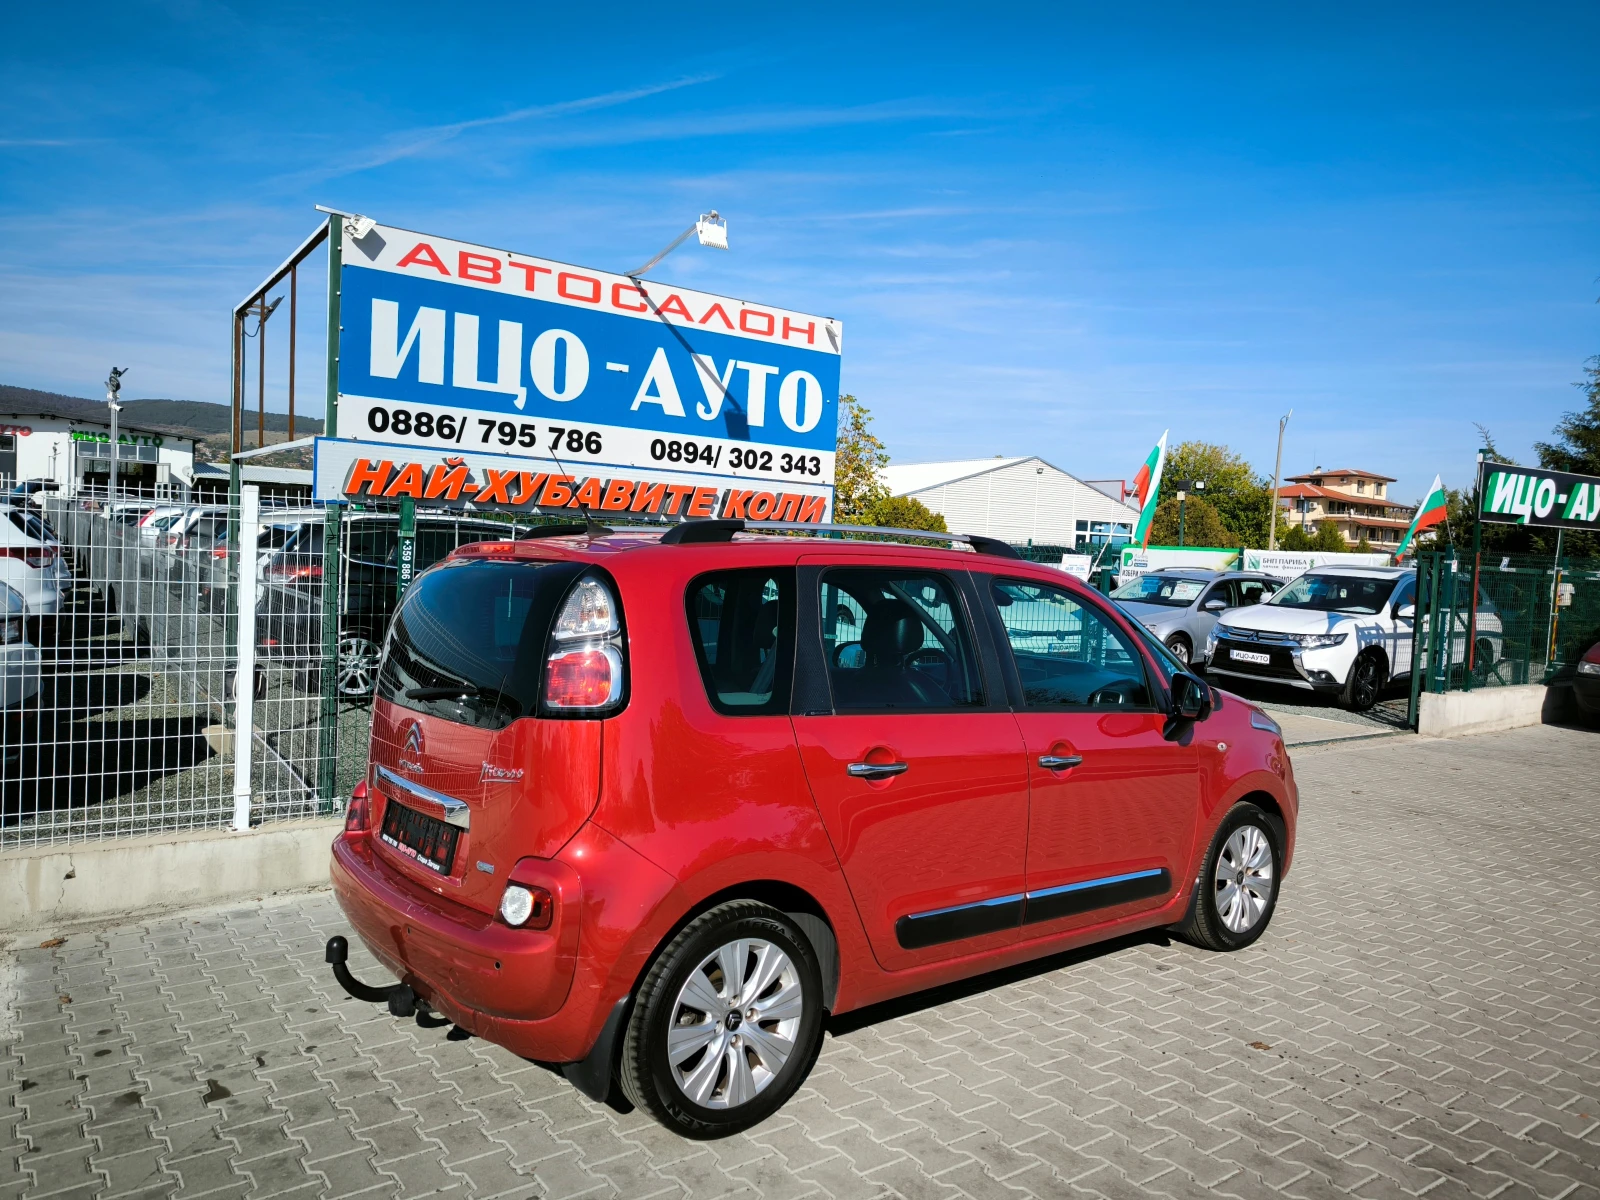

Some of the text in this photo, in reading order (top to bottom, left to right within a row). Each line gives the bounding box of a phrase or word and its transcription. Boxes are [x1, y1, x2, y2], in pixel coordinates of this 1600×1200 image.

[396, 242, 815, 344] АВТОСАЛОН
[367, 406, 602, 454] 0886/ 795 786
[650, 439, 821, 476] 0894/ 302 343
[345, 456, 826, 523] НАЙ-ХУБАВИТЕ КОЛИ
[402, 540, 412, 561] +359
[401, 564, 411, 580] 886
[1235, 652, 1269, 662] ИЦО-АУТО
